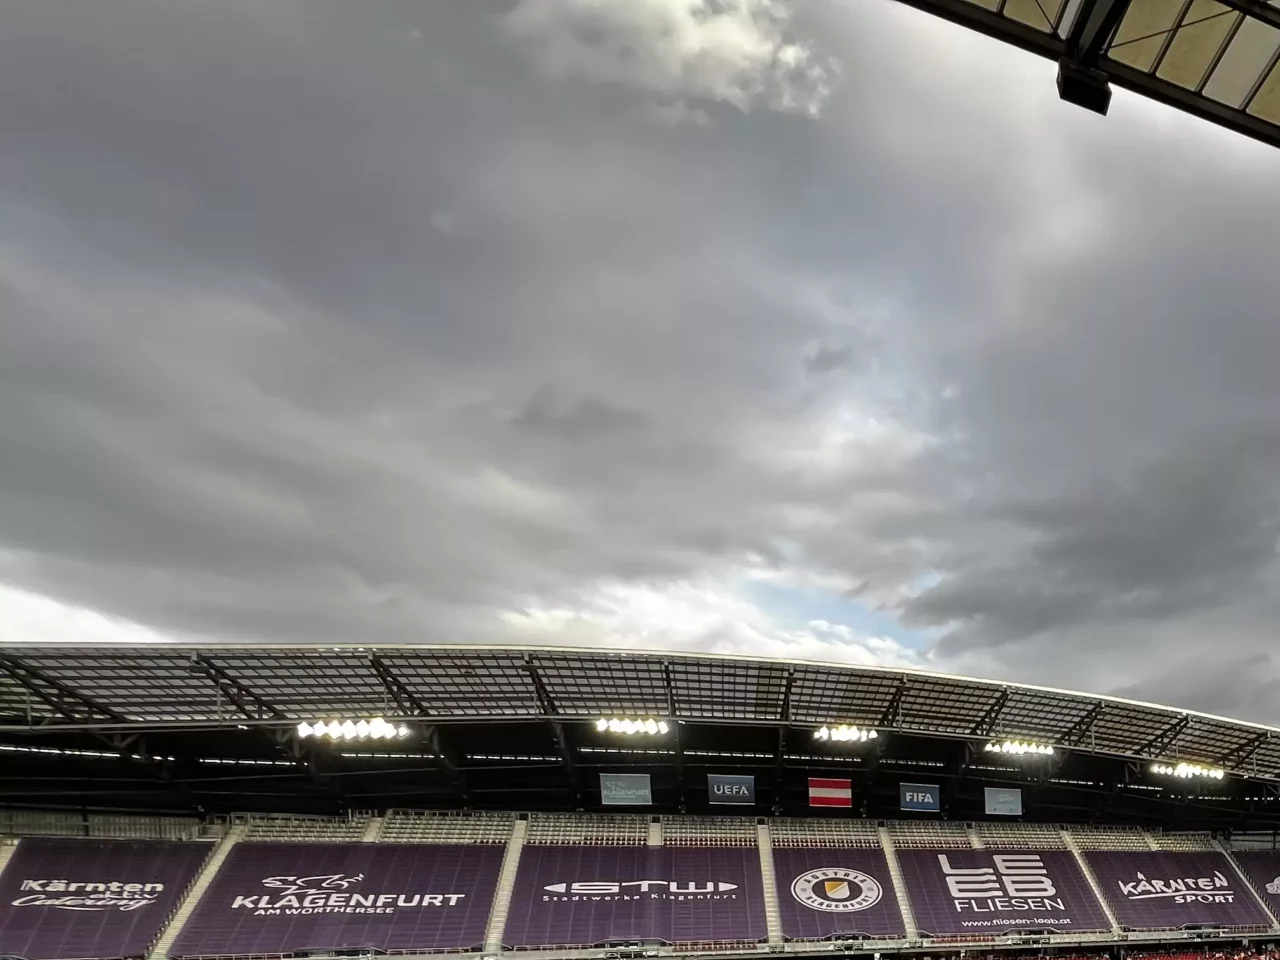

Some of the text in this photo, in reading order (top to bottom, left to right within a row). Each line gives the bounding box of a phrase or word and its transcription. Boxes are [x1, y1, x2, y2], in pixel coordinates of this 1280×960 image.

[714, 784, 749, 796] UEFA
[905, 792, 934, 803] FIFA
[803, 872, 868, 884] AUSTRIA
[24, 879, 164, 892] Kärnten
[570, 880, 714, 893] STW
[11, 894, 156, 911] Catering
[231, 894, 466, 908] KLAGENFURT
[542, 892, 737, 902] Stadtwerke Klagenfurt
[804, 895, 873, 908] KLAGENFURT
[1174, 894, 1234, 904] SPORT
[954, 898, 1066, 912] FLIESEN
[254, 908, 281, 916] AM
